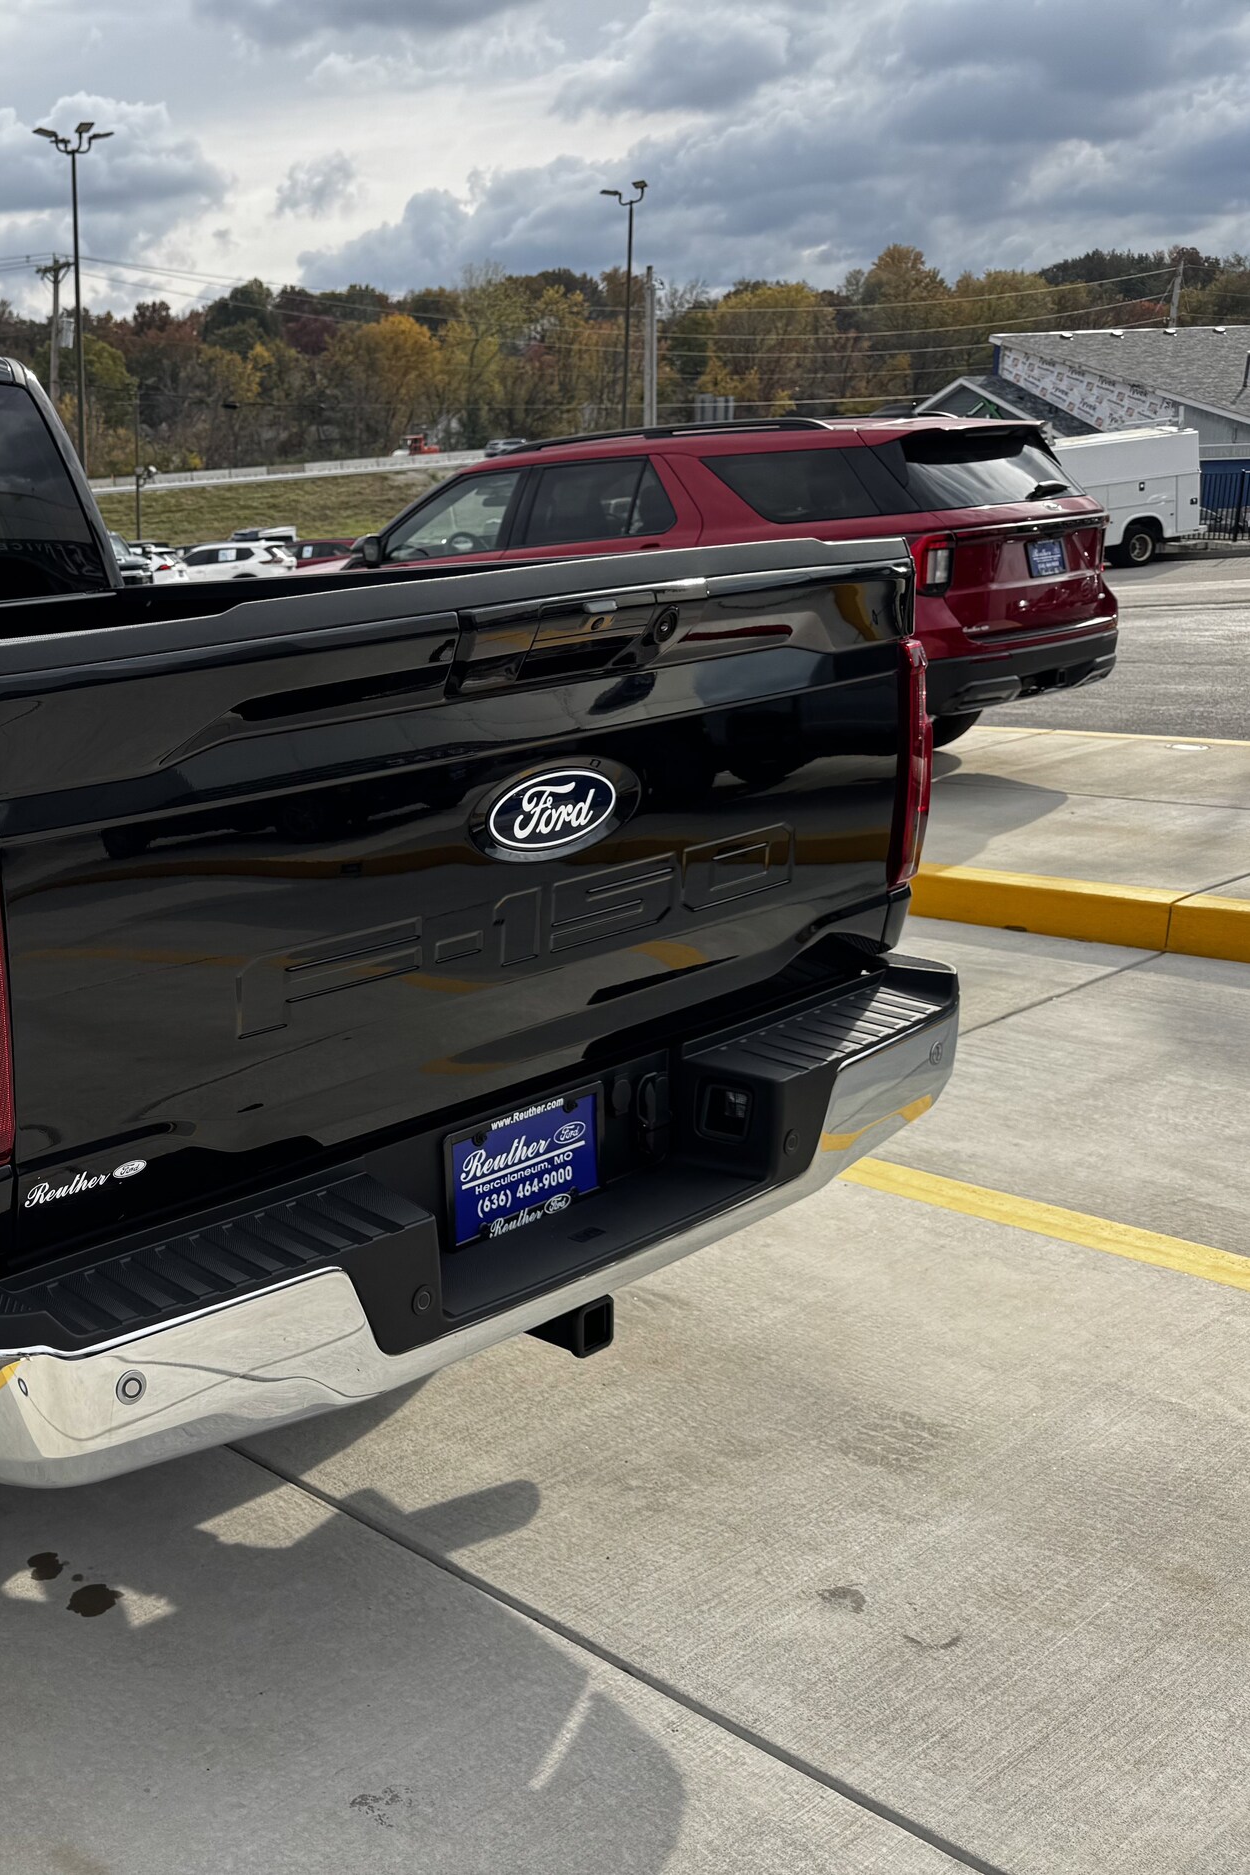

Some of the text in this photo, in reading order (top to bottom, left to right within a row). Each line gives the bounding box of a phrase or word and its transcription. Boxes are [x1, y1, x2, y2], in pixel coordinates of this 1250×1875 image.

[511, 779, 598, 840] Ford
[236, 822, 795, 1039] F-150
[490, 1098, 564, 1131] www.Reuther.com
[460, 1135, 552, 1182] Reuther
[553, 1151, 573, 1166] MO
[24, 1170, 111, 1208] Reuther
[477, 1165, 573, 1218] (636) 464-9000
[489, 1207, 545, 1239] Reuther
